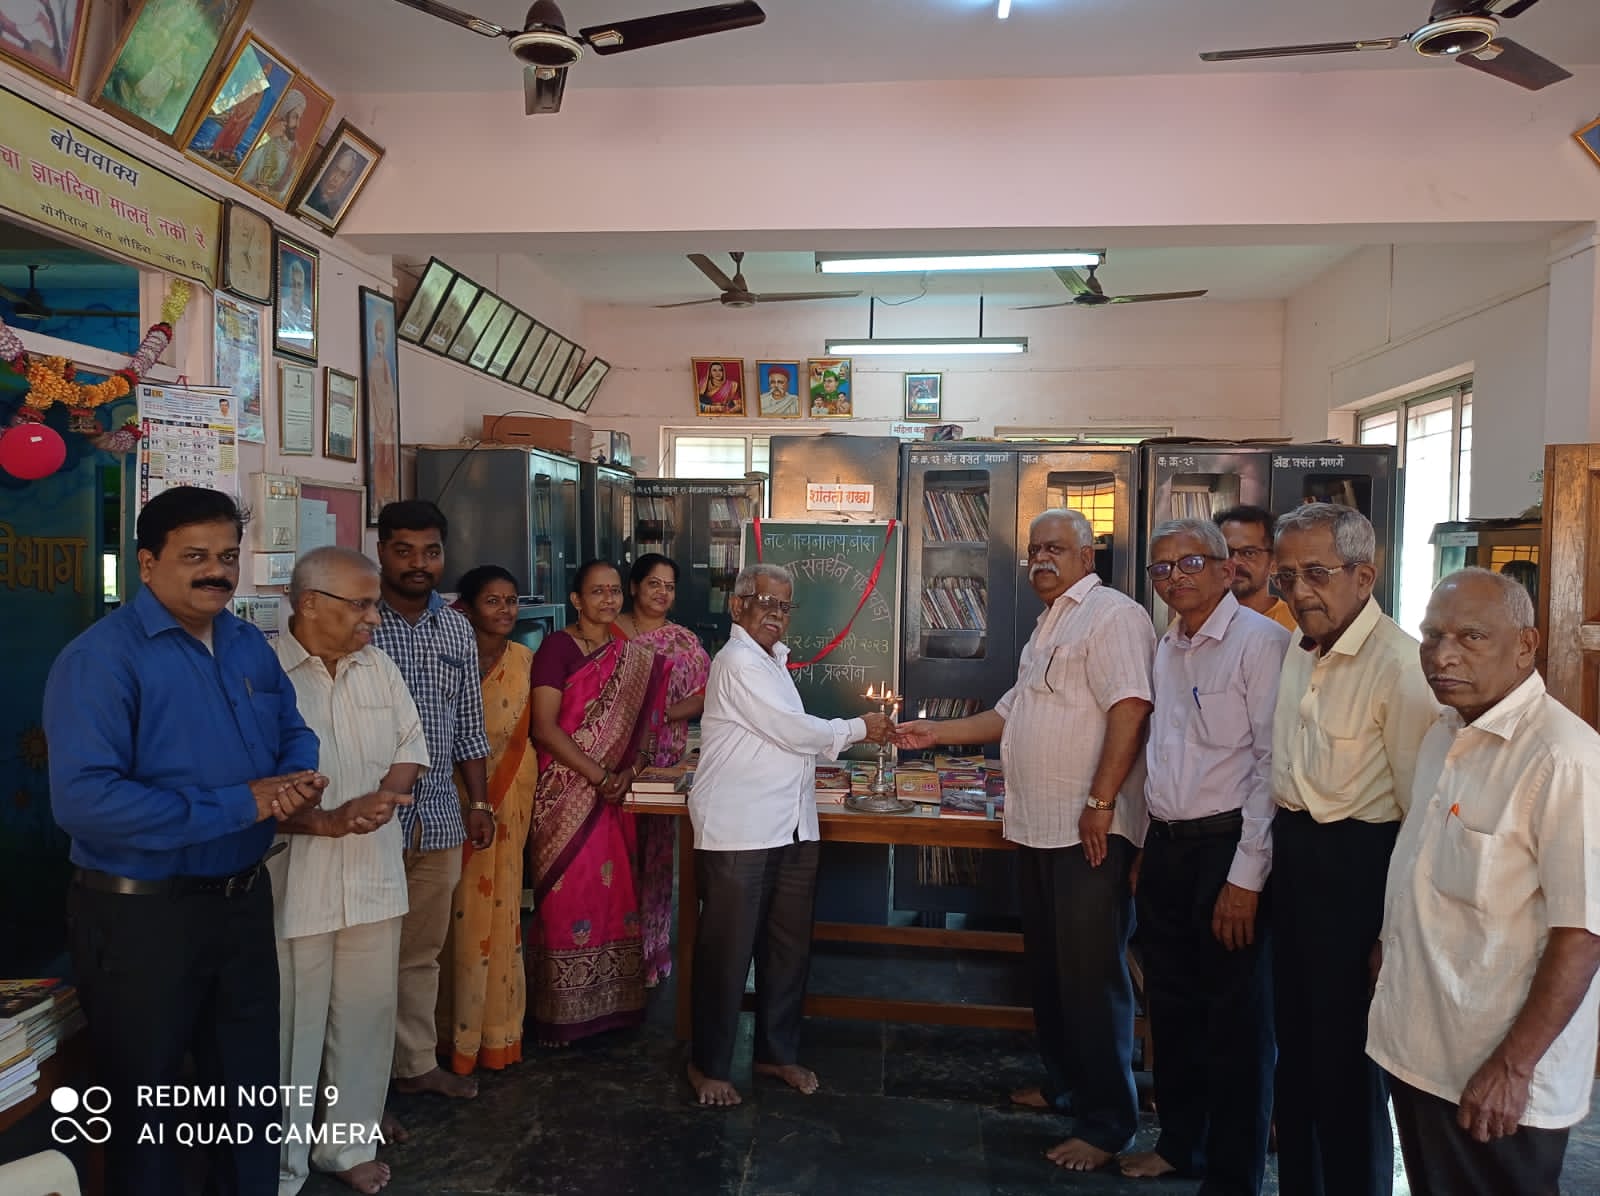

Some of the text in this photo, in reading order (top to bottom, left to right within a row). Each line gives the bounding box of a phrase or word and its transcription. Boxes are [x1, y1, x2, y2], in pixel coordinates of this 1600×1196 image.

[50, 128, 138, 186] बोधवाक्य
[30, 160, 101, 207] ज्ञानदिवा
[159, 217, 188, 244] नको
[195, 227, 207, 248] रे
